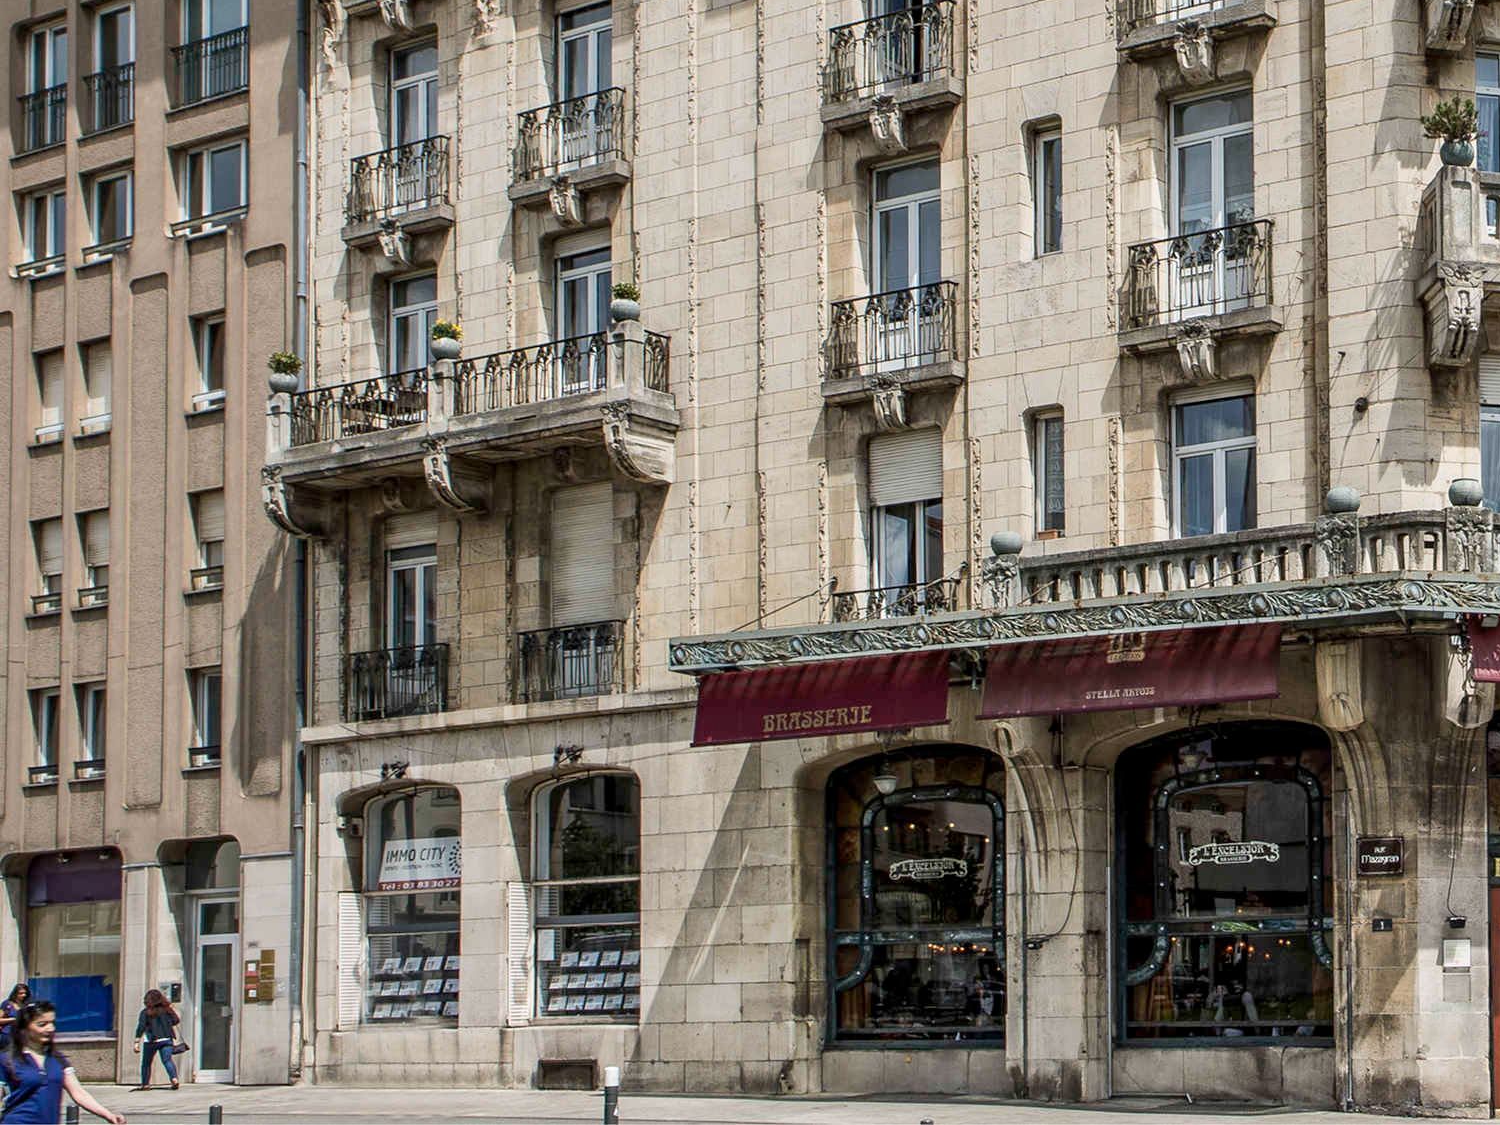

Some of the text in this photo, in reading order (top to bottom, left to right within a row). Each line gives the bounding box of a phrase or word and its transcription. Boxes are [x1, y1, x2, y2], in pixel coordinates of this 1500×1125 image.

[1085, 686, 1156, 700] STELLA ARTOIS
[762, 705, 873, 732] BRASSERIE
[386, 846, 446, 863] IMMO CITY
[1361, 854, 1400, 865] Mazagran
